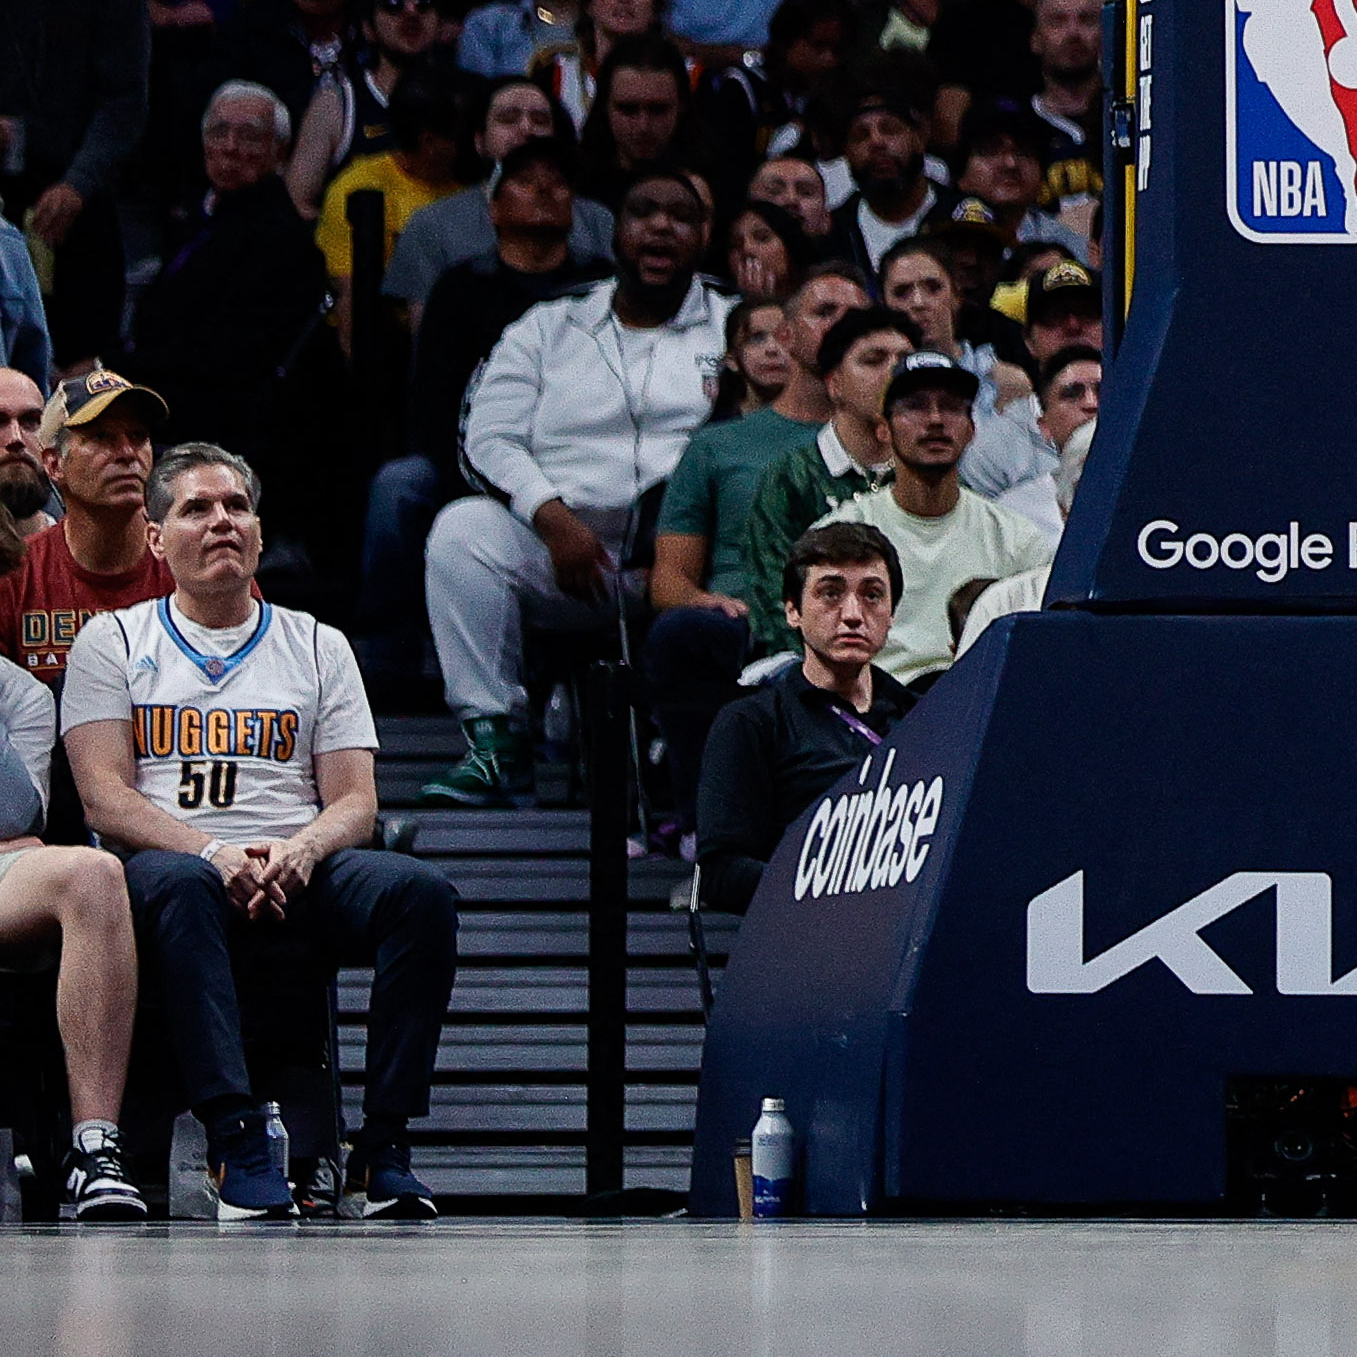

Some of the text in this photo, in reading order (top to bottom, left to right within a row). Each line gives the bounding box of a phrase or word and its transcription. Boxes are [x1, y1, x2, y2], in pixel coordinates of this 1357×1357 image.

[1253, 160, 1327, 217] NBA
[1137, 519, 1333, 583] Google
[132, 705, 299, 763] NUGGETS
[178, 761, 238, 810] 50
[795, 747, 943, 901] coinbase
